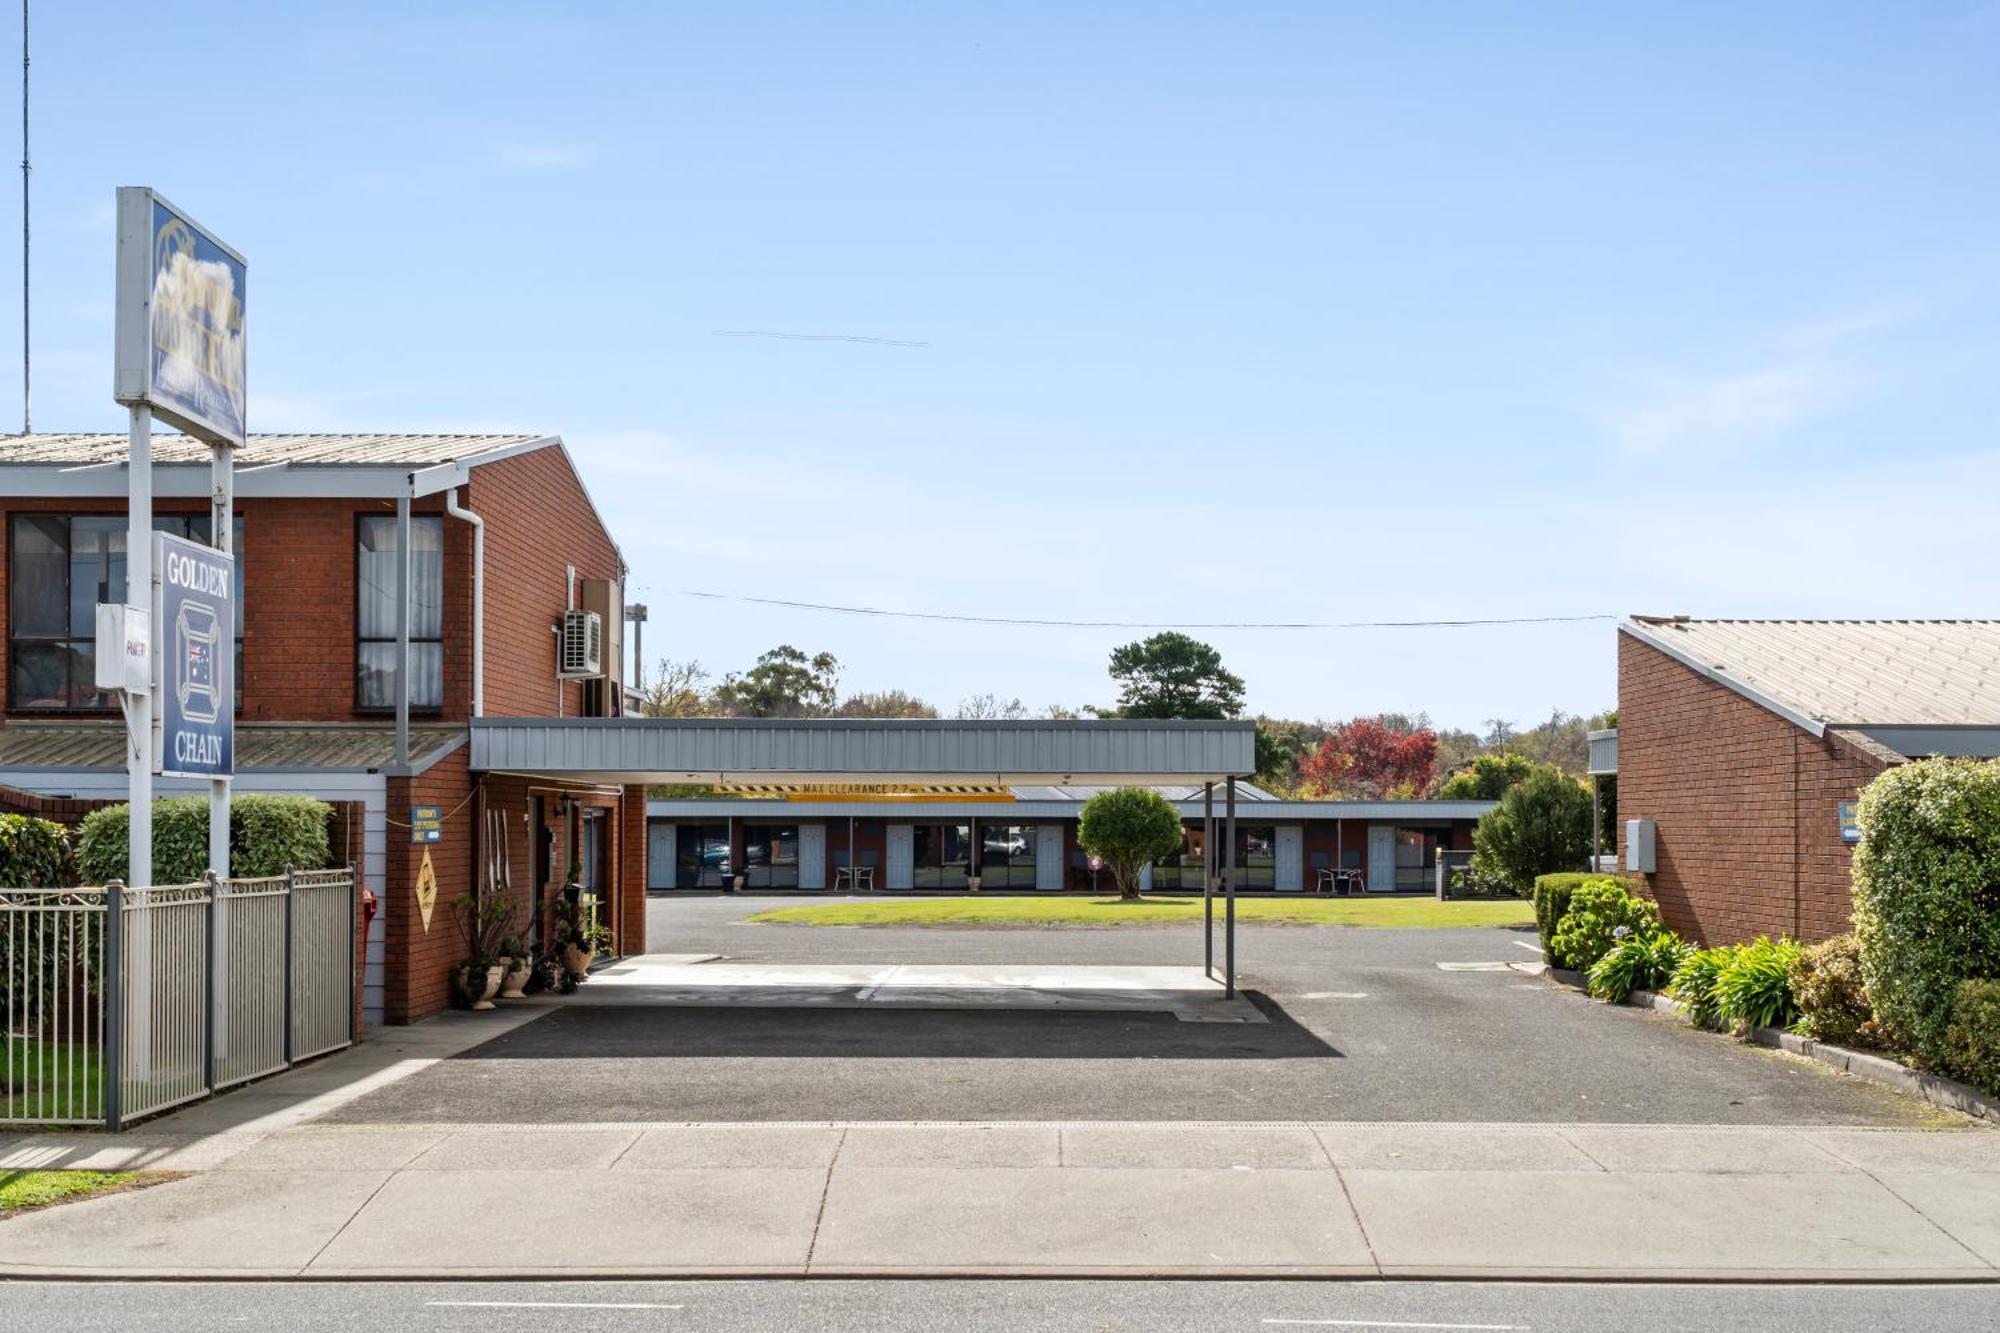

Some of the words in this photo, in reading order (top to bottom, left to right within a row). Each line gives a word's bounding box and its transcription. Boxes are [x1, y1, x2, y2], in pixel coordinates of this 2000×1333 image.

[167, 551, 228, 599] GOLDEN
[175, 730, 222, 766] CHAIN
[803, 783, 824, 793] MAX
[829, 783, 887, 793] CLEARANCE
